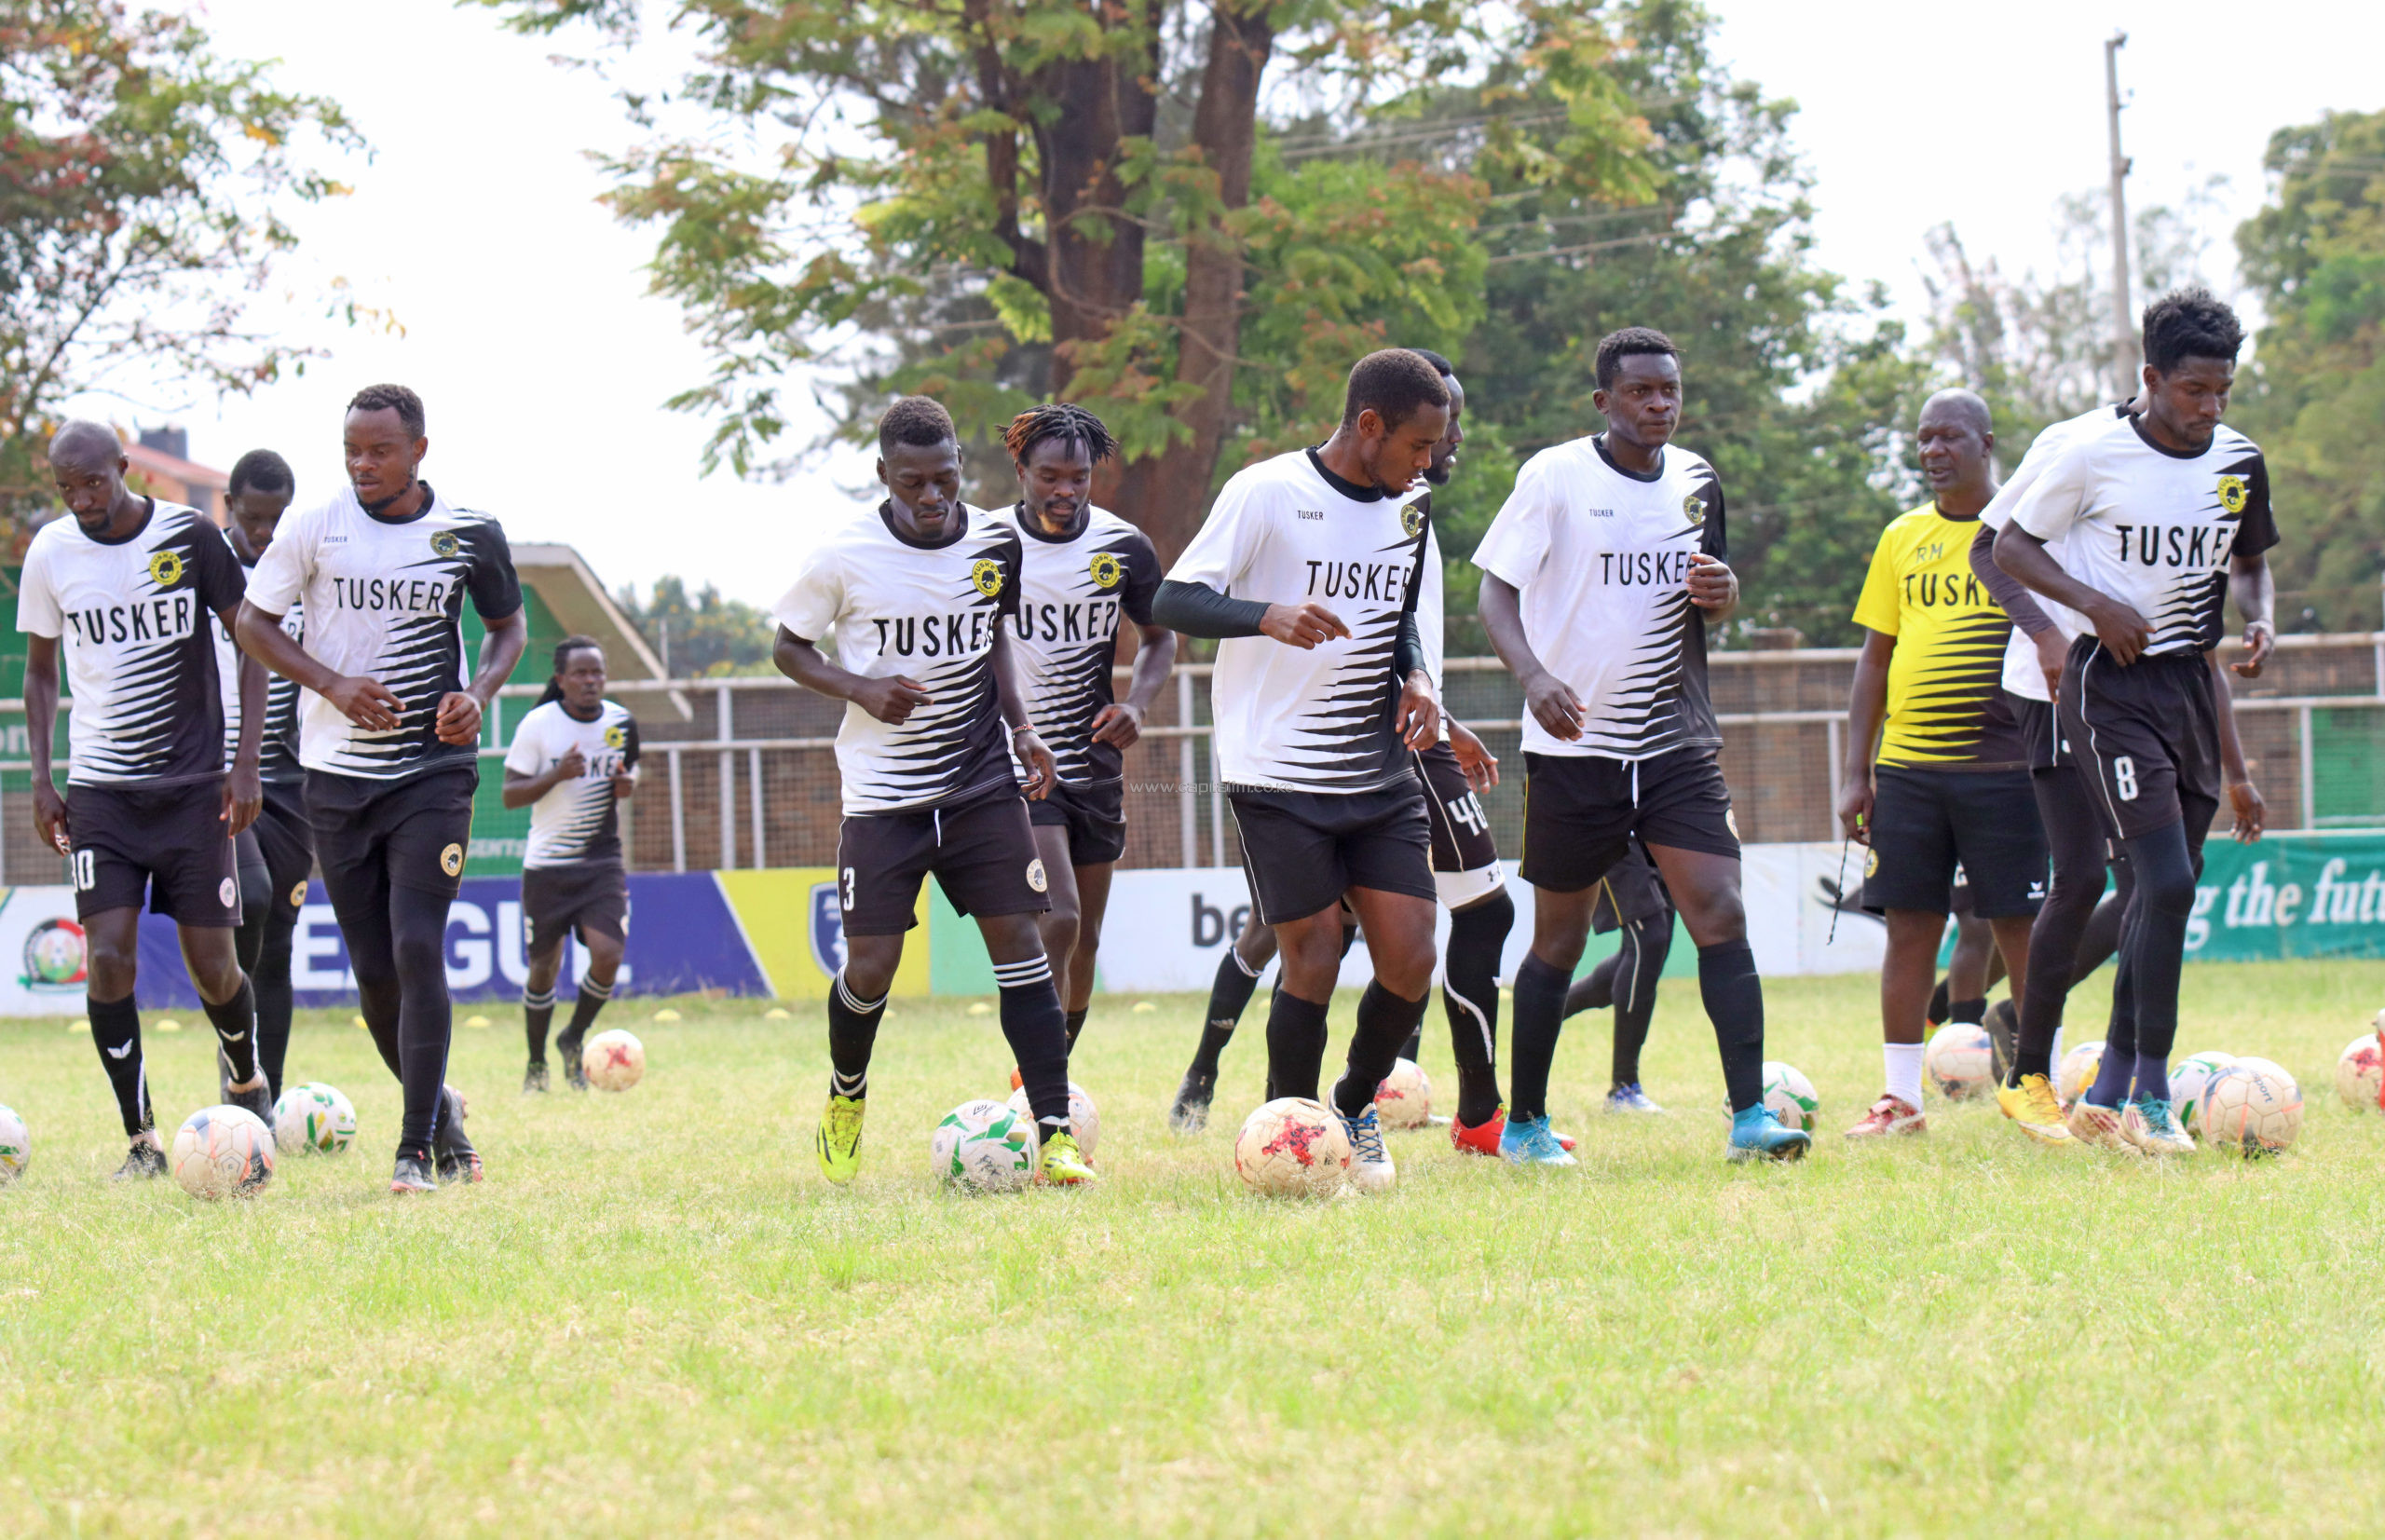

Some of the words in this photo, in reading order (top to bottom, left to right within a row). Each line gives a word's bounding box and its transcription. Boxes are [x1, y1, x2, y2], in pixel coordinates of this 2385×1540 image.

[1297, 510, 1324, 521] TUSKER
[1589, 509, 1614, 517] TUSKER
[2115, 525, 2237, 566] TUSKE
[334, 578, 444, 612] TUSKER
[1904, 572, 2000, 607] TUSK
[67, 596, 189, 647] TUSKER
[1015, 601, 1117, 642] USKER
[2114, 756, 2138, 801] 8
[843, 866, 855, 911] 3
[2225, 861, 2302, 928] the
